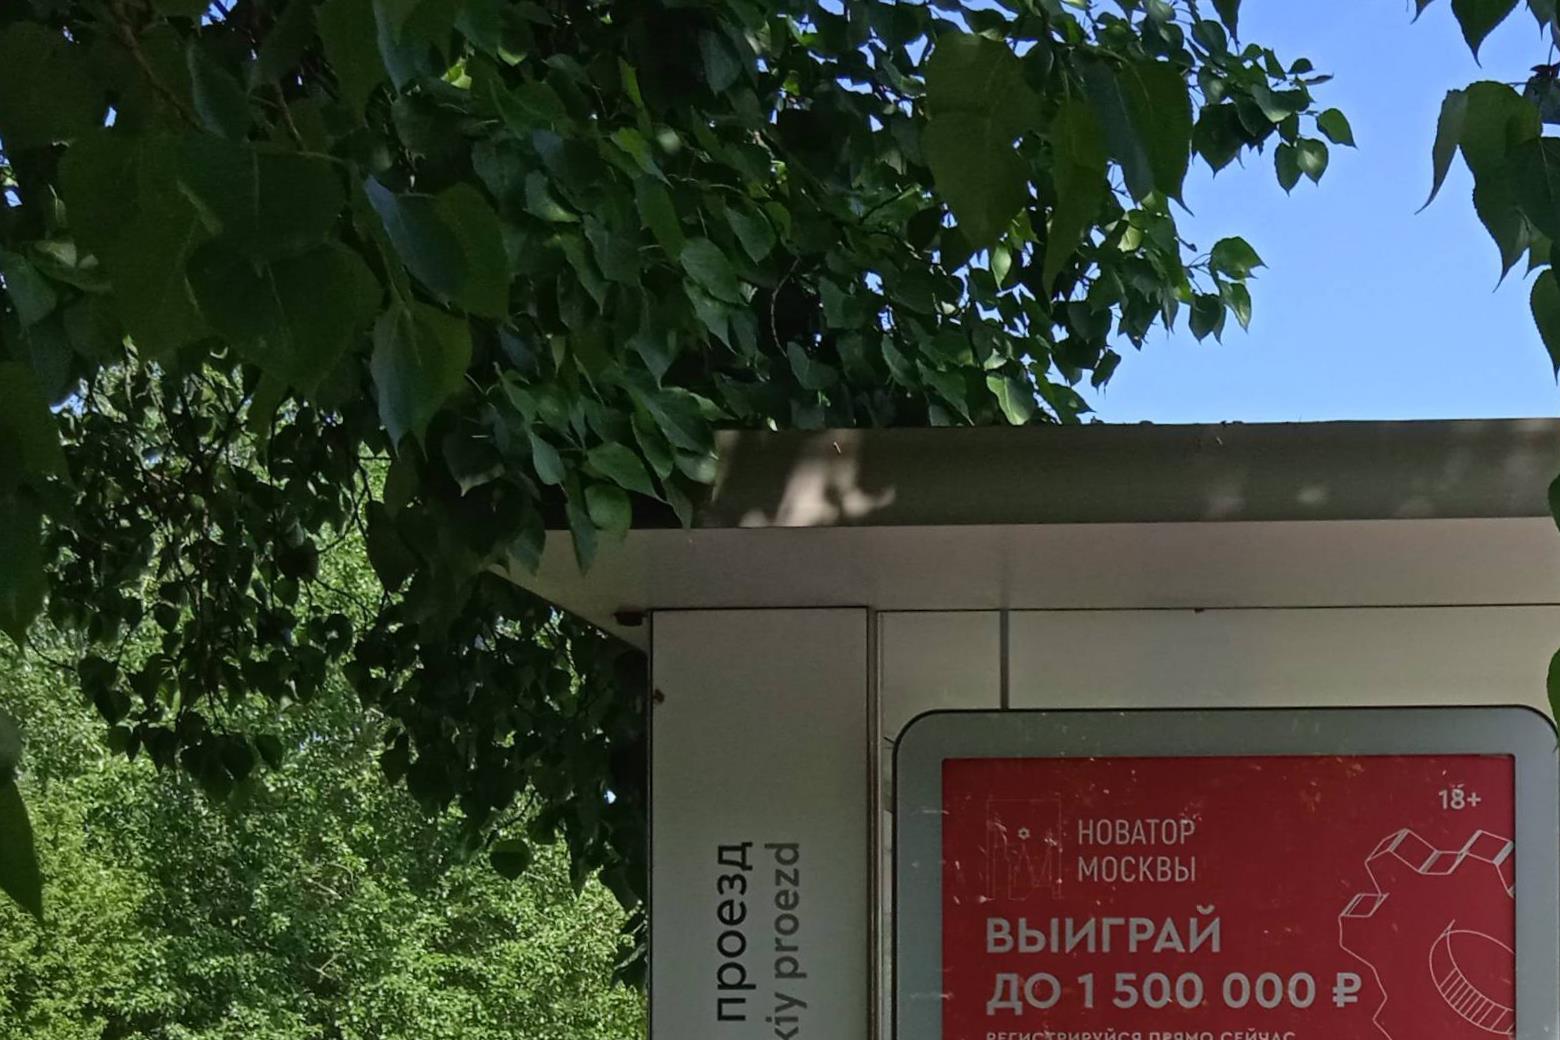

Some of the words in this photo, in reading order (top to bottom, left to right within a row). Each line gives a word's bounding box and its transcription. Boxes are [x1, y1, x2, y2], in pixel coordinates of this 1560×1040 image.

[1438, 788, 1482, 811] 18+
[1077, 819, 1197, 846] НОВАТОР
[1077, 856, 1197, 883] МОСКВЫ
[715, 841, 757, 1021] проезд
[764, 841, 807, 980] proezd
[986, 905, 1221, 954] ВЫИГРАЙ
[986, 972, 1061, 1016] ДО
[1078, 973, 1093, 1008] 1
[1113, 972, 1205, 1009] 500
[1222, 972, 1317, 1009] 000
